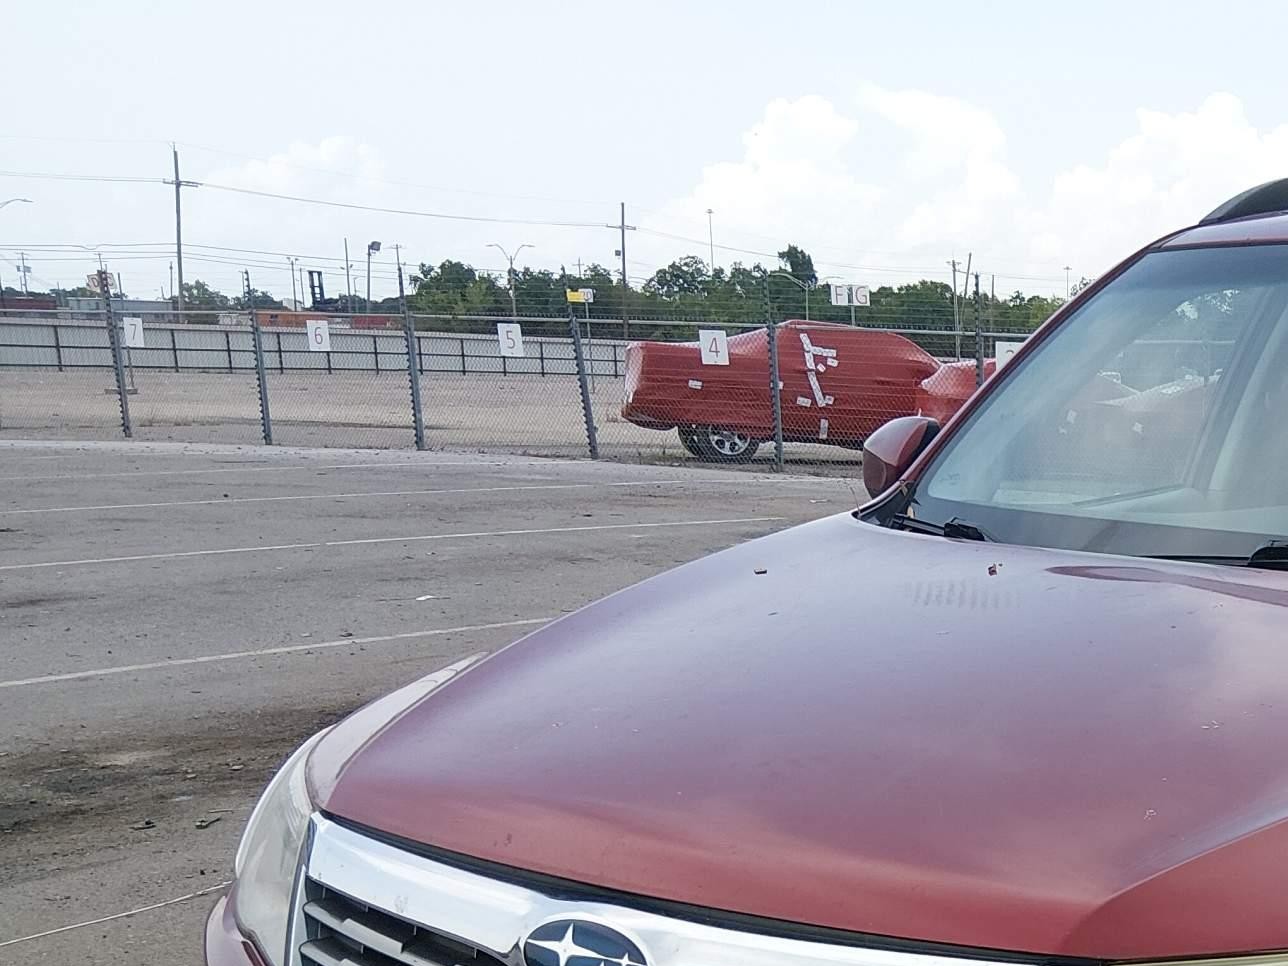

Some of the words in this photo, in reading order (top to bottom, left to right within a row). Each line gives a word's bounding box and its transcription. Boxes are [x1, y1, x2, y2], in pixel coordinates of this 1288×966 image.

[835, 286, 844, 304] F
[856, 286, 868, 304] G
[129, 323, 137, 341] 7
[314, 326, 324, 345] 6
[505, 330, 516, 349] 5
[709, 337, 721, 358] 4
